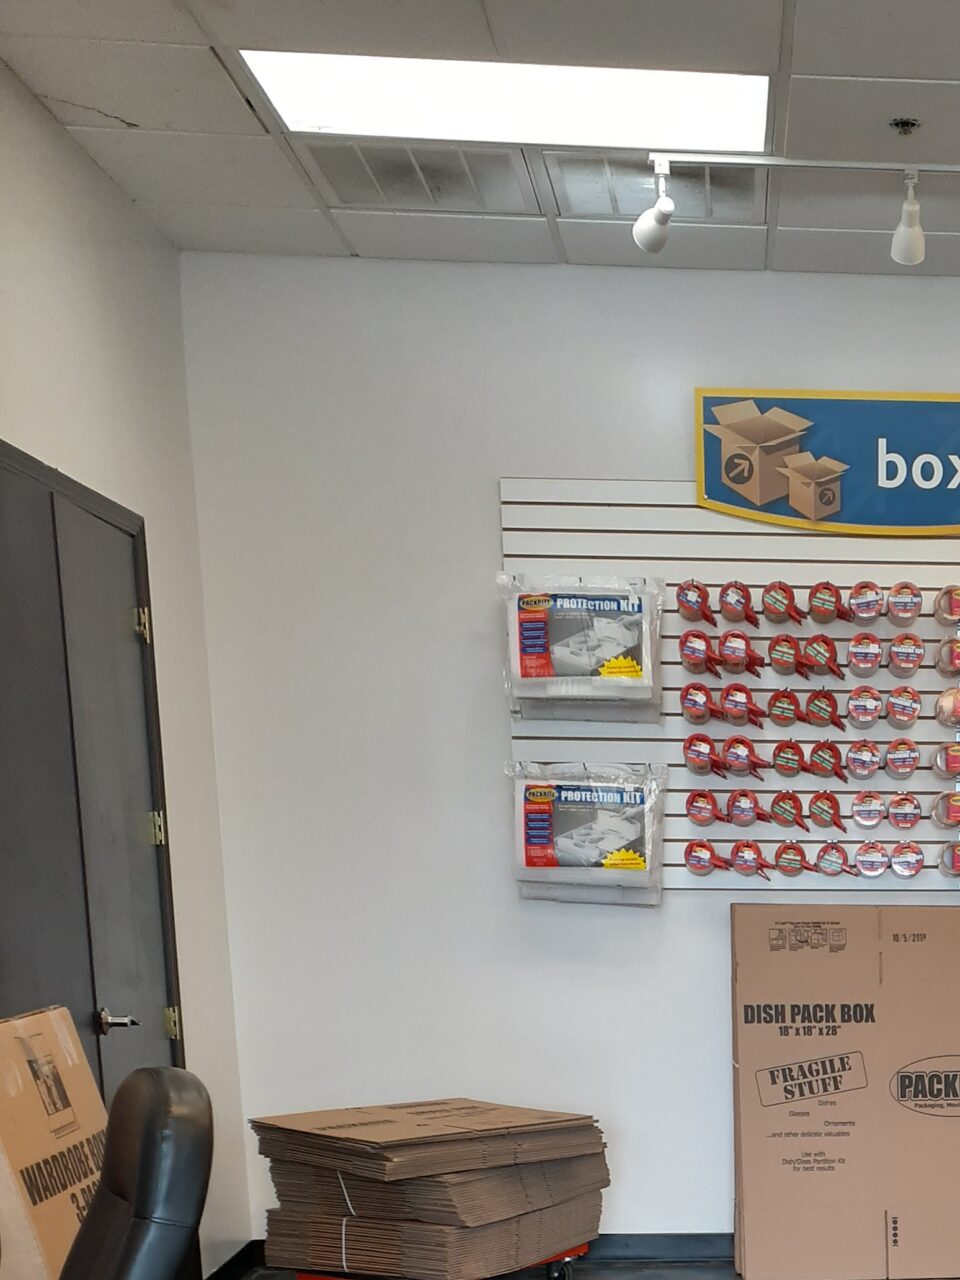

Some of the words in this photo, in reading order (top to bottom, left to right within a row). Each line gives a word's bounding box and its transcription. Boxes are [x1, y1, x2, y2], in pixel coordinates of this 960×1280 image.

[557, 598, 618, 611] PROTECTION
[620, 599, 640, 612] KIT
[561, 790, 621, 803] PROTECTION
[623, 790, 643, 804] KIT
[744, 1004, 786, 1024] DISH
[790, 1004, 837, 1024] PACK
[840, 1003, 876, 1023] BOX
[768, 1056, 852, 1086] FRAGILE
[783, 1074, 843, 1100] STUFF
[914, 1102, 945, 1110] Packaging,
[19, 1141, 95, 1207] WARDROBE
